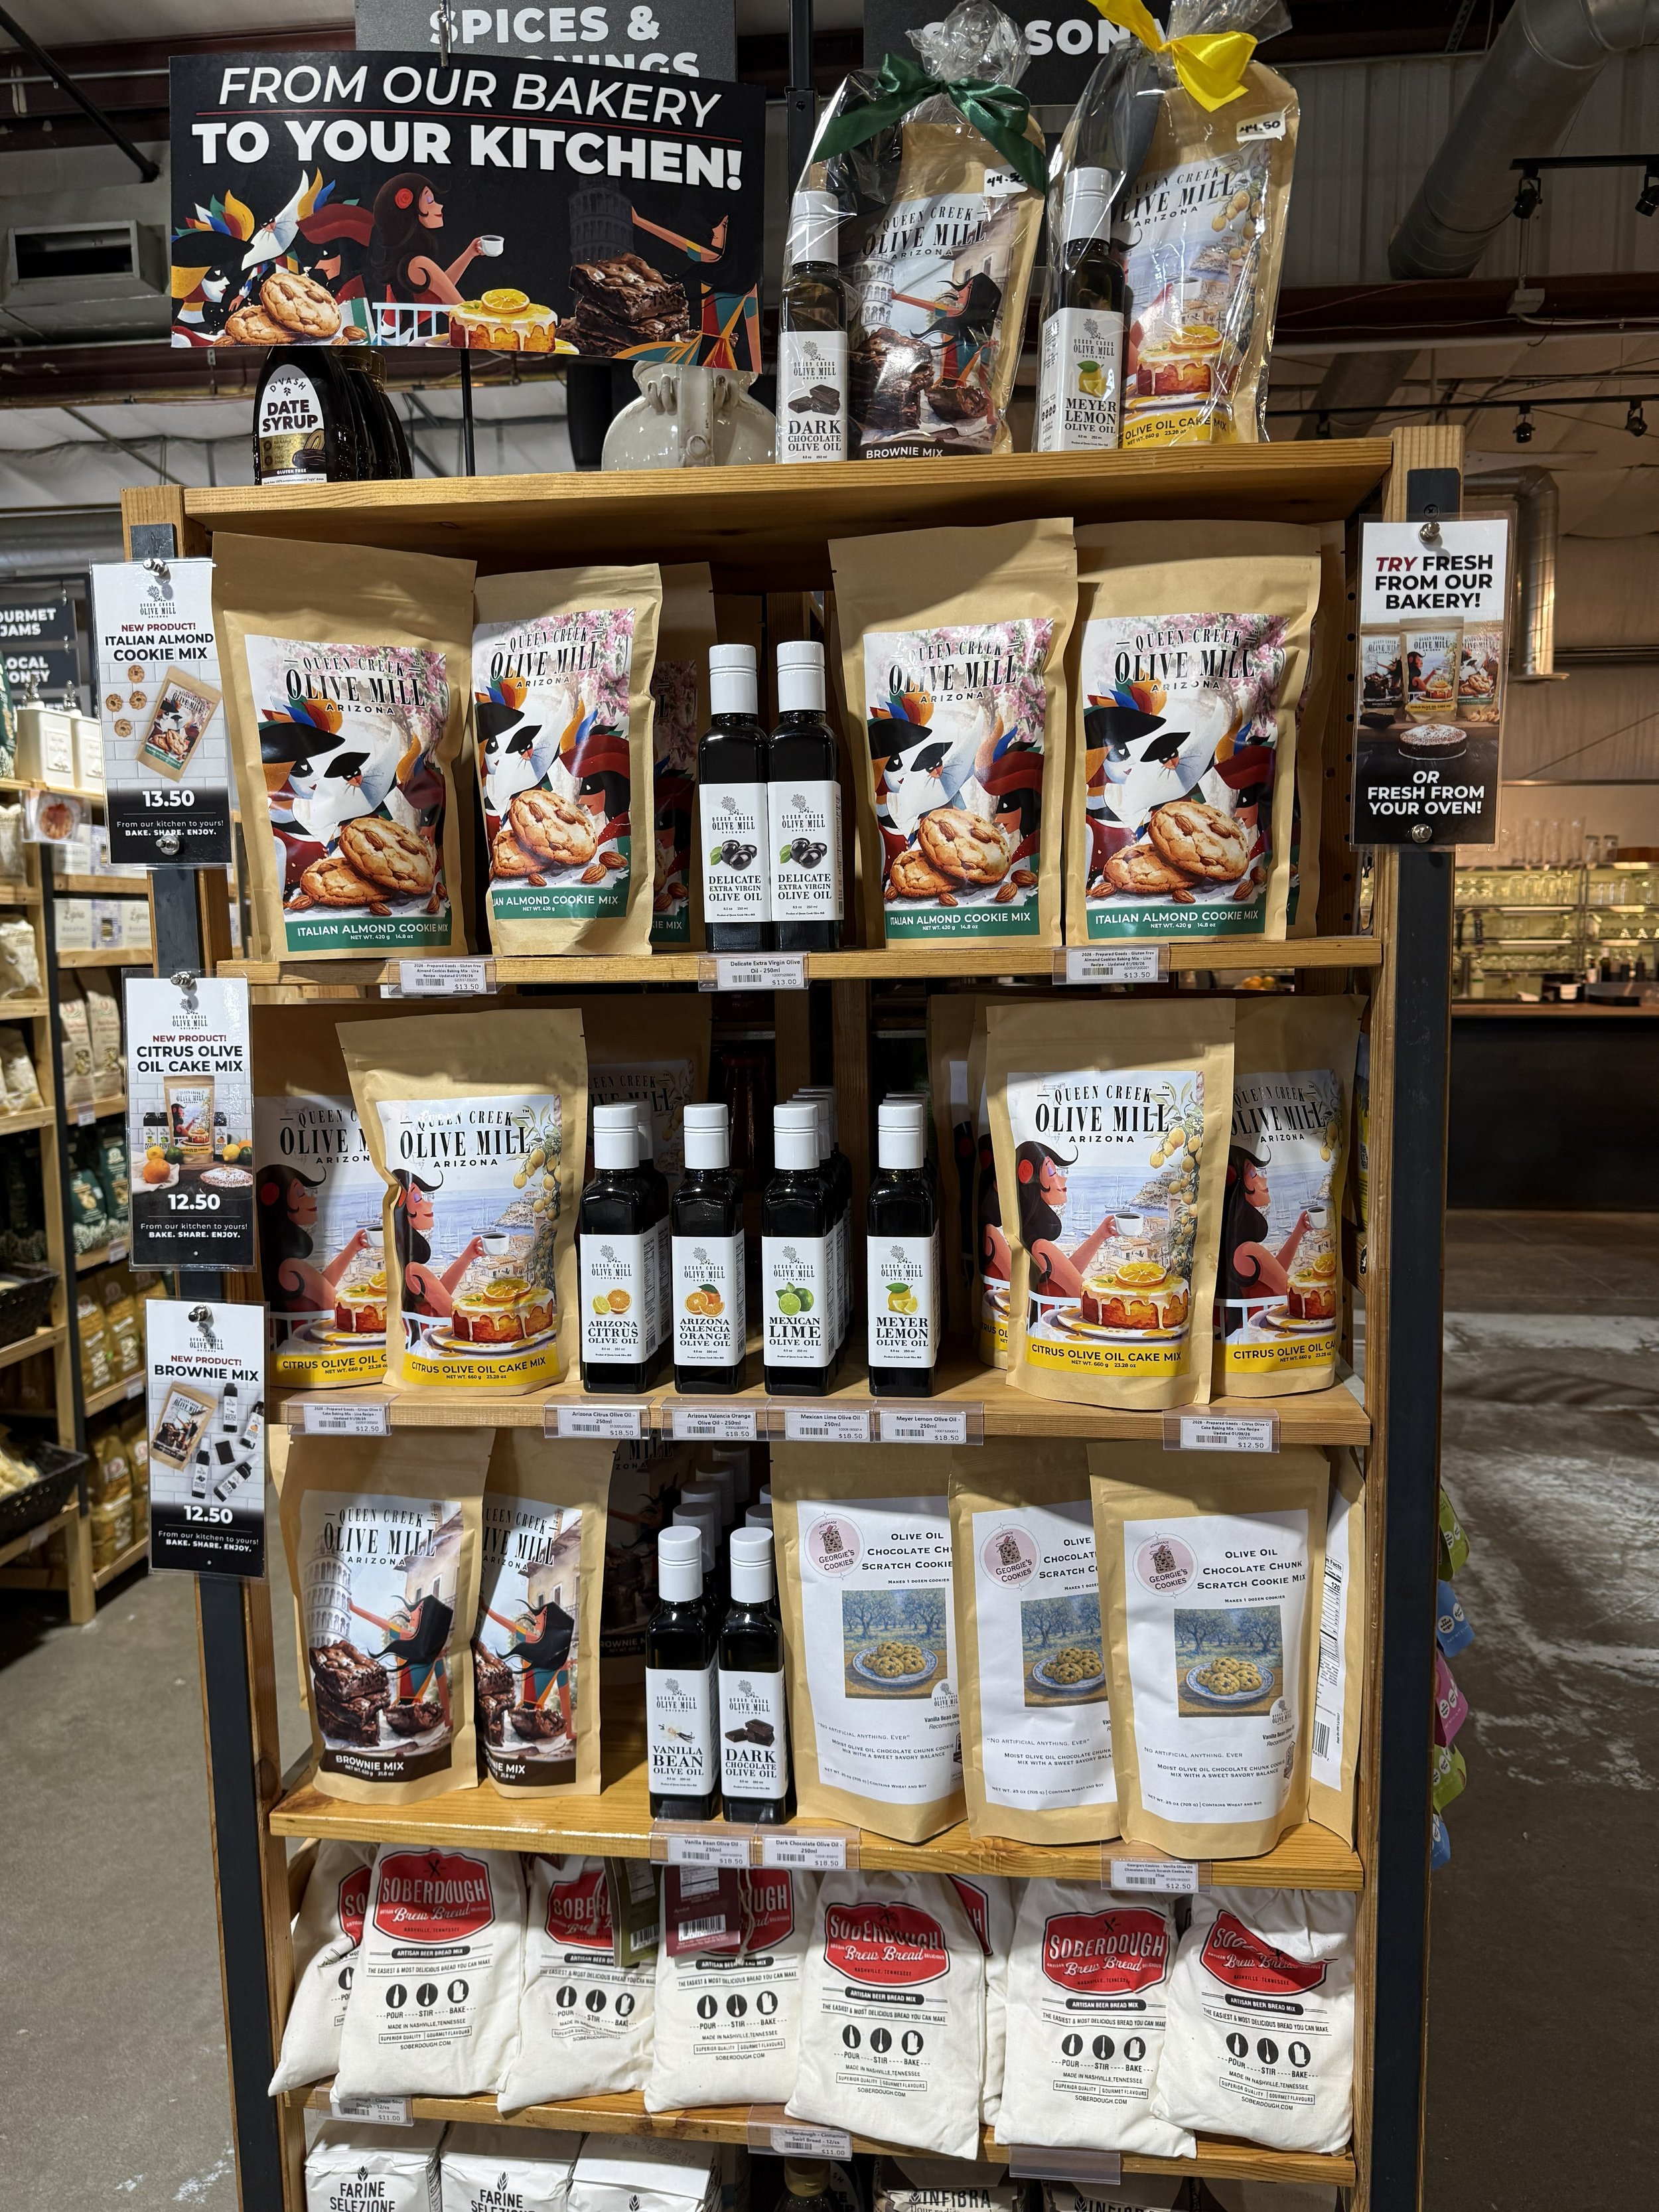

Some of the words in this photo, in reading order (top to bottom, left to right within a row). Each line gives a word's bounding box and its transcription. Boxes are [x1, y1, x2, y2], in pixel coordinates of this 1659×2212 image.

[429, 7, 609, 44] SPICES
[627, 6, 660, 40] &
[218, 66, 366, 106] FROM
[383, 69, 497, 108] OUR
[513, 77, 722, 128] BAKERY
[192, 122, 269, 164] TO
[284, 120, 451, 165] YOUR
[470, 125, 742, 191] KITCHEN!
[883, 210, 924, 232] QUEEN
[930, 206, 974, 220] CREEK
[863, 226, 926, 256] OLIVE
[932, 220, 987, 247] MILL
[267, 400, 309, 416] DATE
[1066, 398, 1116, 412] MEYER
[262, 415, 318, 432] SYRUP
[1065, 411, 1116, 425] LEMON
[1064, 423, 1095, 433] OLIVE
[1099, 425, 1116, 433] OIL
[866, 447, 918, 459] BROWNIE
[922, 449, 943, 457] MIX
[1376, 556, 1419, 572] TRY
[1423, 554, 1492, 570] FRESH
[1375, 575, 1437, 591] FROM
[1445, 573, 1492, 589] OUR
[1386, 593, 1480, 609] BAKERY!
[0, 608, 56, 623] OURMET
[147, 623, 196, 631] PRODUCT!
[105, 636, 154, 646] ITALIAN
[159, 634, 214, 644] ALMOND
[113, 648, 174, 661] COOKIE
[179, 647, 207, 660] MIX
[4, 656, 48, 670] OCAL
[303, 657, 350, 672] QUEEN
[358, 658, 404, 676] CREEK
[286, 669, 360, 701] OLIVE
[368, 678, 425, 707] MILL
[326, 703, 394, 715] ARIZONA
[1413, 771, 1439, 784] OR
[142, 790, 194, 807] 13.50
[1368, 786, 1425, 800] FRESH
[1431, 785, 1484, 798] FROM
[1369, 802, 1420, 816] YOUR
[1424, 800, 1482, 814] OVEN!
[744, 893, 762, 901] OIL
[297, 925, 338, 936] ITALIAN
[342, 924, 396, 934] ALMOND
[399, 924, 436, 932] COOKIE
[438, 924, 448, 932] MIX
[137, 1045, 194, 1057] CITRUS
[198, 1045, 243, 1057] OLIVE
[137, 1061, 165, 1073] OIL
[169, 1061, 211, 1072] CAKE
[214, 1060, 244, 1072] MIX
[1054, 1086, 1100, 1104] QUEEN
[1106, 1084, 1153, 1103] CREEK
[1035, 1104, 1102, 1134] OLIVE
[1113, 1103, 1169, 1134] MILL
[1068, 1135, 1135, 1144] ARIZONA
[167, 1194, 220, 1211] 12.50
[876, 1317, 928, 1327] MEYER
[588, 1328, 638, 1337] CITRUS
[769, 1325, 820, 1338] LIME
[876, 1328, 928, 1339] LEMON
[1031, 1343, 1064, 1358] CITRUS
[1068, 1351, 1102, 1361] OLIVE
[1105, 1352, 1125, 1361] OIL
[1128, 1353, 1160, 1362] CAKE
[1164, 1351, 1181, 1362] MIX
[154, 1364, 227, 1380] BROWNIE
[232, 1368, 259, 1382] MIX
[184, 1505, 233, 1524] 12.50
[339, 1508, 377, 1524] QUEEN
[384, 1509, 423, 1528] CREEK
[325, 1522, 379, 1554] OLIVE
[386, 1528, 437, 1557] MILL
[1149, 1569, 1188, 1584] GEORGIE'S
[1155, 1578, 1187, 1590] COOKIES
[653, 1746, 703, 1755] VANILLA
[725, 1749, 776, 1763] DARK
[335, 1755, 381, 1771] BROWNIE
[384, 1761, 404, 1771] MIX
[653, 1755, 703, 1768] BEAN
[725, 1762, 776, 1771] CHOCOLATE
[382, 1877, 486, 1905] SOBERDOUGH
[392, 1907, 428, 1922] Brew
[430, 1903, 470, 1919] Bread
[1049, 1932, 1164, 1959] SOBERDOUGH
[1064, 1962, 1100, 1976] Brew
[1102, 1956, 1141, 1972] Bread
[340, 2181, 386, 2198] FARINE
[330, 2197, 396, 2212] SELEZIONE
[920, 2189, 991, 2209] INFIBRA
